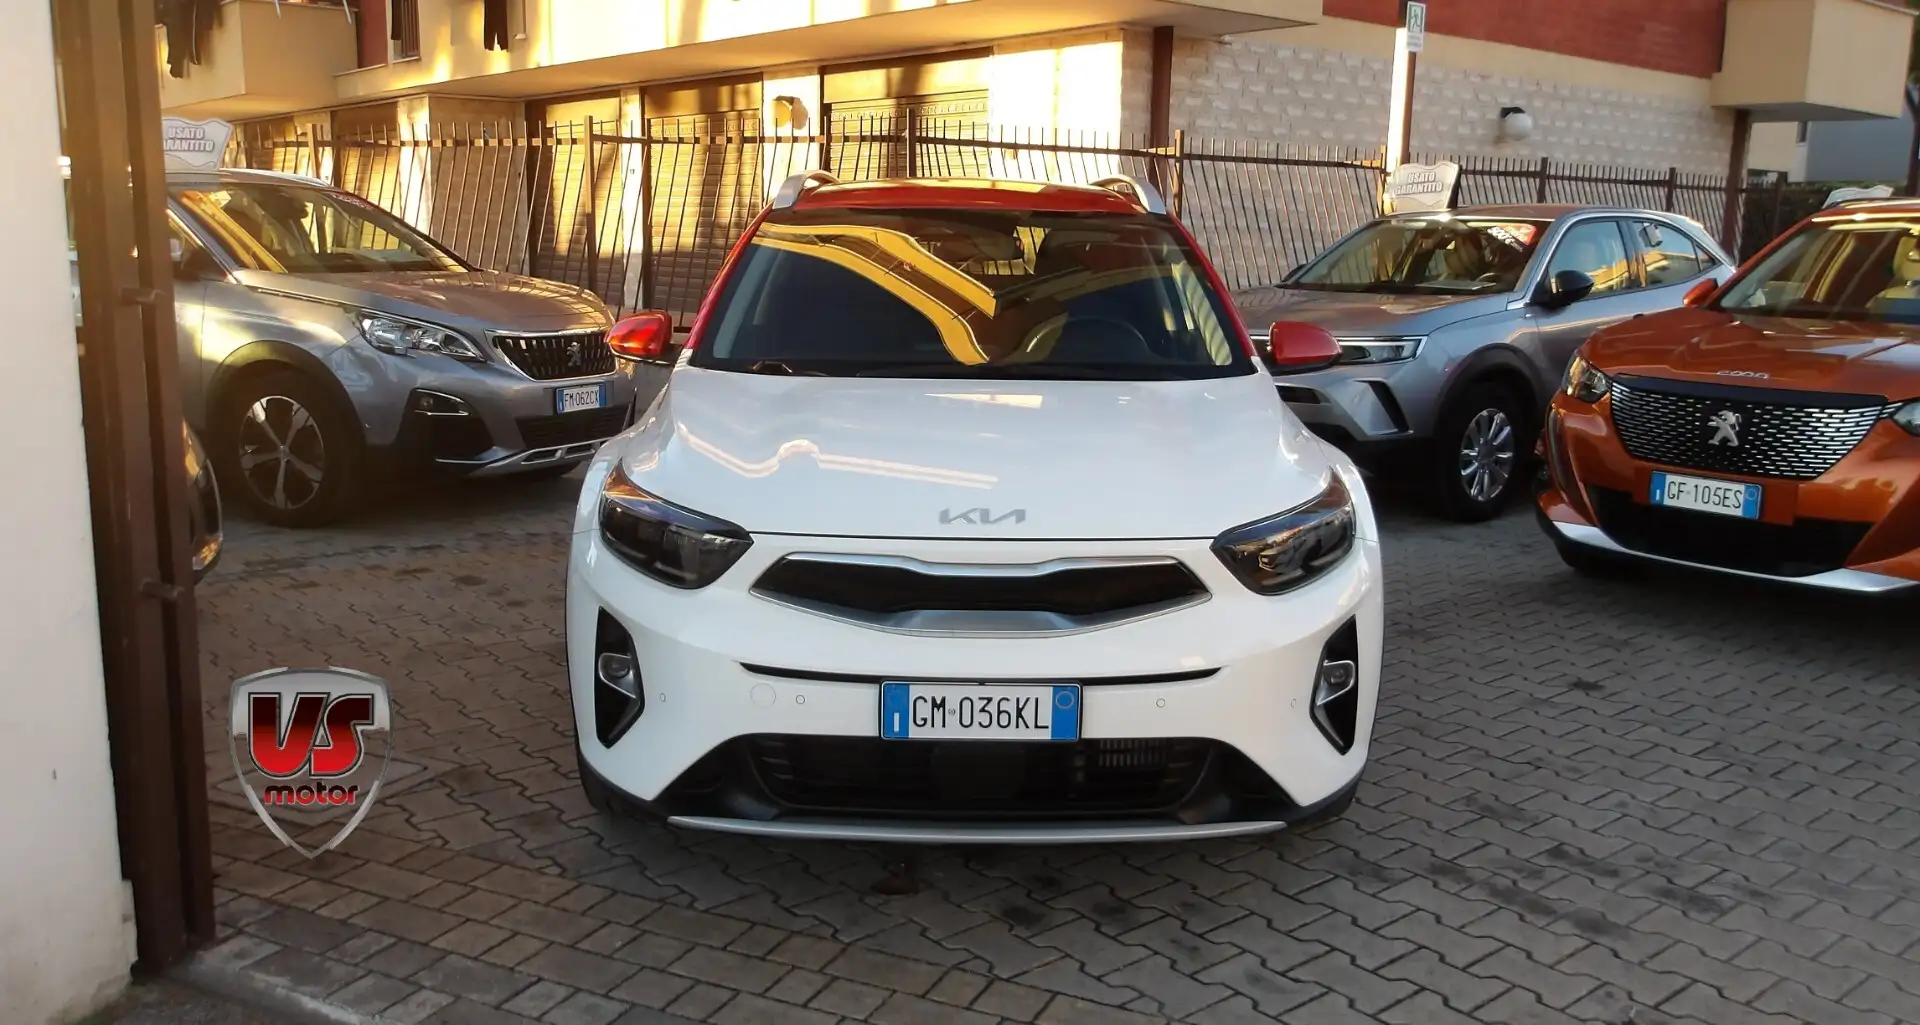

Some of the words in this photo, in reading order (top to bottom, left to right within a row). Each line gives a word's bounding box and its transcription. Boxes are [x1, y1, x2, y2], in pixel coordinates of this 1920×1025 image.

[168, 127, 205, 139] USATO
[164, 140, 215, 152] RANTITO
[1407, 171, 1435, 183] USATO
[1395, 182, 1443, 195] GARANTITO
[939, 508, 1026, 524] KIA
